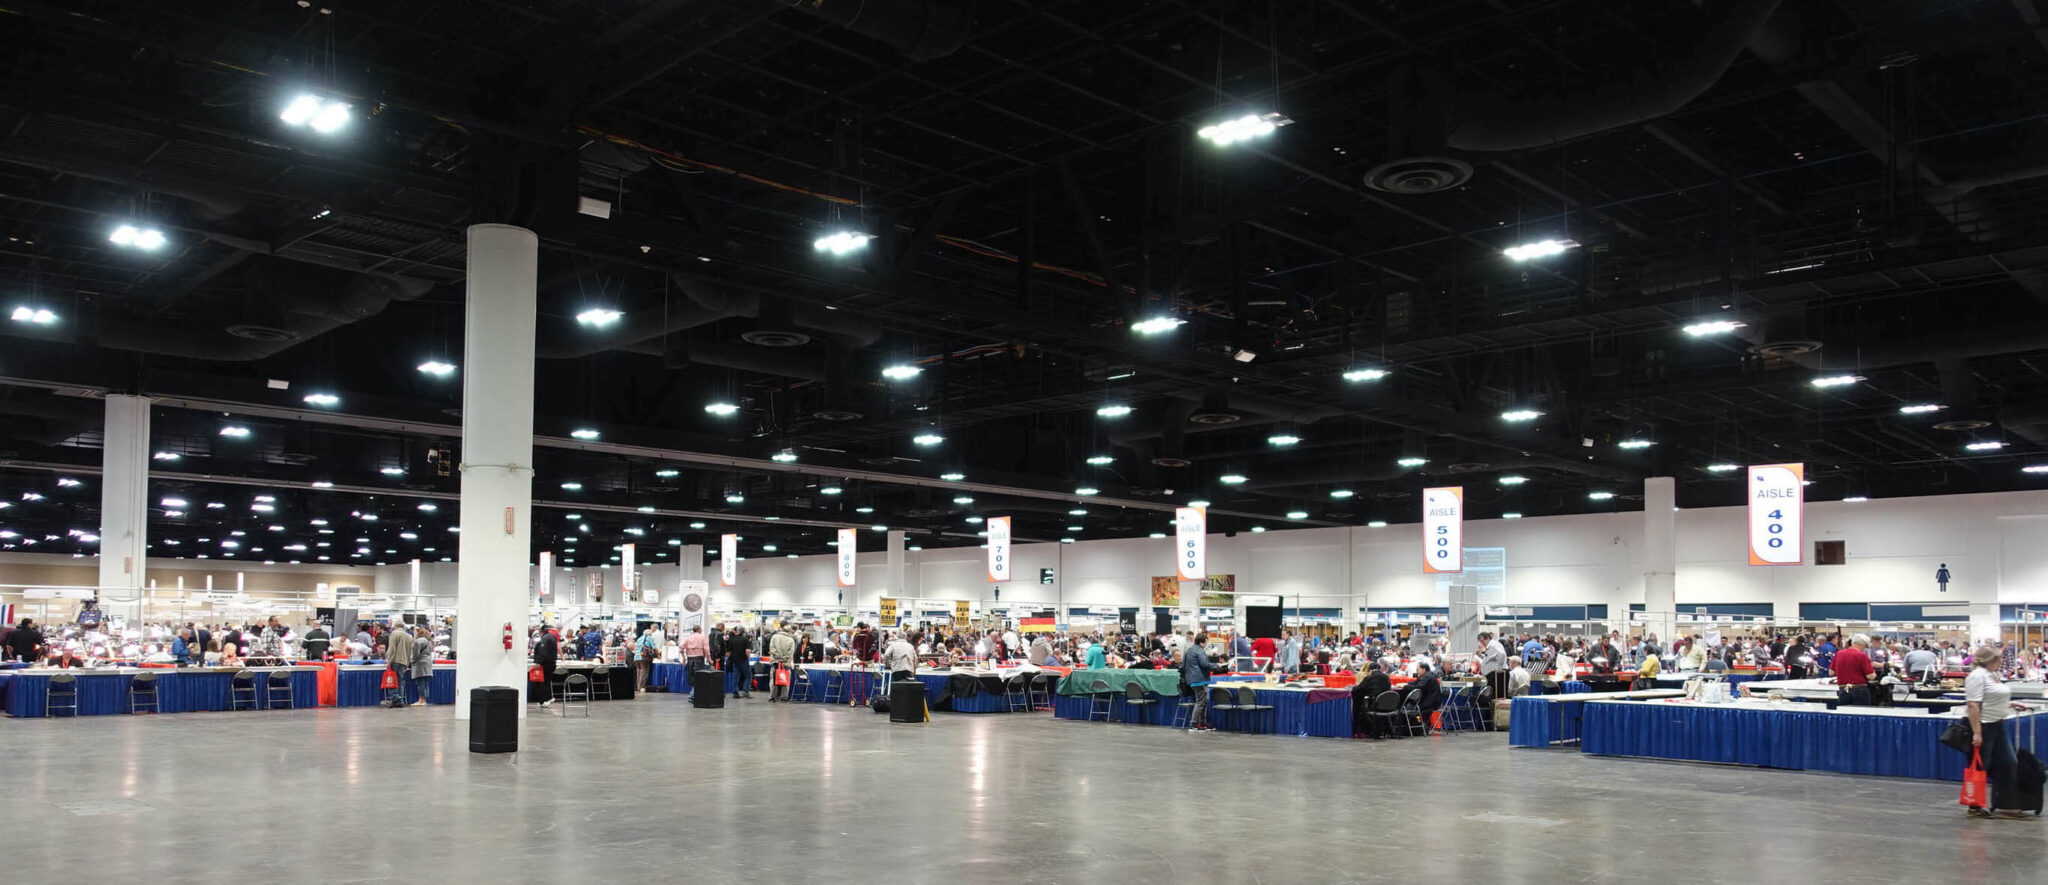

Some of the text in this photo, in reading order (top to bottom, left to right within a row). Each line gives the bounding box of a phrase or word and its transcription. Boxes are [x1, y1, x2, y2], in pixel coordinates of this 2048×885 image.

[1757, 488, 1794, 498] AISLE
[1430, 507, 1456, 517] AISLE
[1437, 525, 1448, 558] 500
[1768, 509, 1783, 548] 400
[1187, 540, 1195, 568] 600
